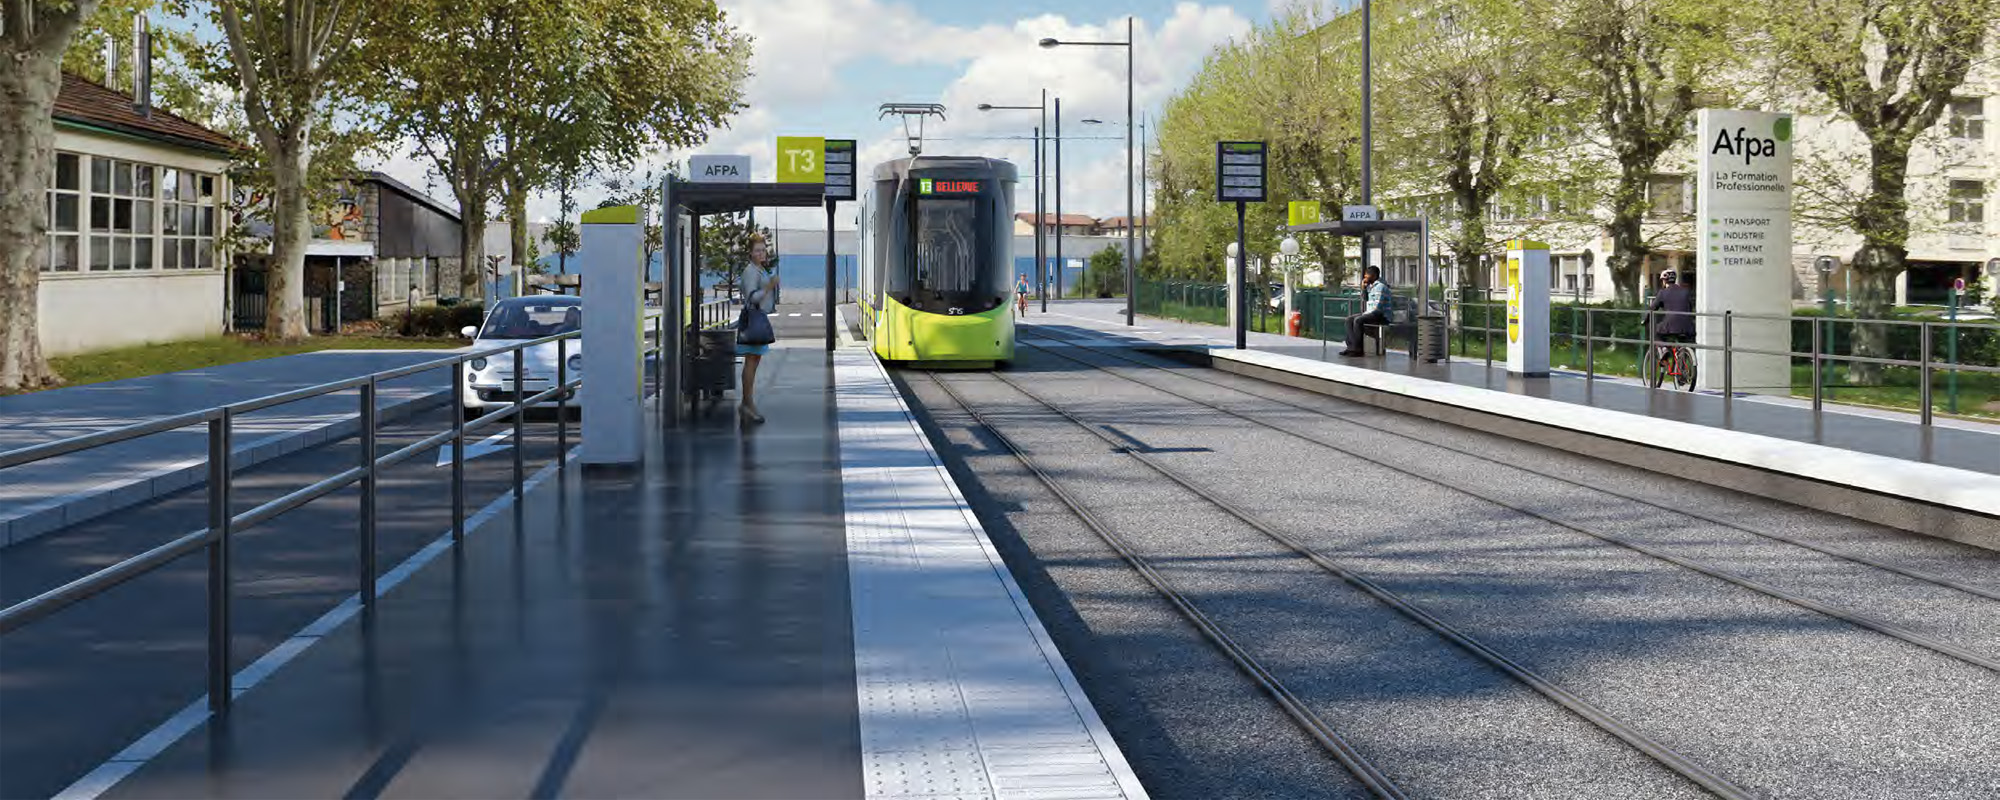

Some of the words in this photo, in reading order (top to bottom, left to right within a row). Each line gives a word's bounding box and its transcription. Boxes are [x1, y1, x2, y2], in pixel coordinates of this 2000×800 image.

[1712, 127, 1775, 165] Afpa
[785, 149, 815, 173] T3
[705, 165, 738, 176] AFPA
[1716, 171, 1728, 181] La
[1731, 171, 1778, 182] Formation
[920, 181, 932, 192] T3
[1716, 181, 1785, 192] Professionnelle
[1300, 205, 1316, 220] T3
[1350, 211, 1371, 219] AFPA
[1724, 218, 1771, 226] TRANSPORT
[1724, 232, 1764, 240] INDUSTRIE
[1723, 244, 1763, 253] BATIMENT
[1724, 257, 1764, 266] TERTIAIRE
